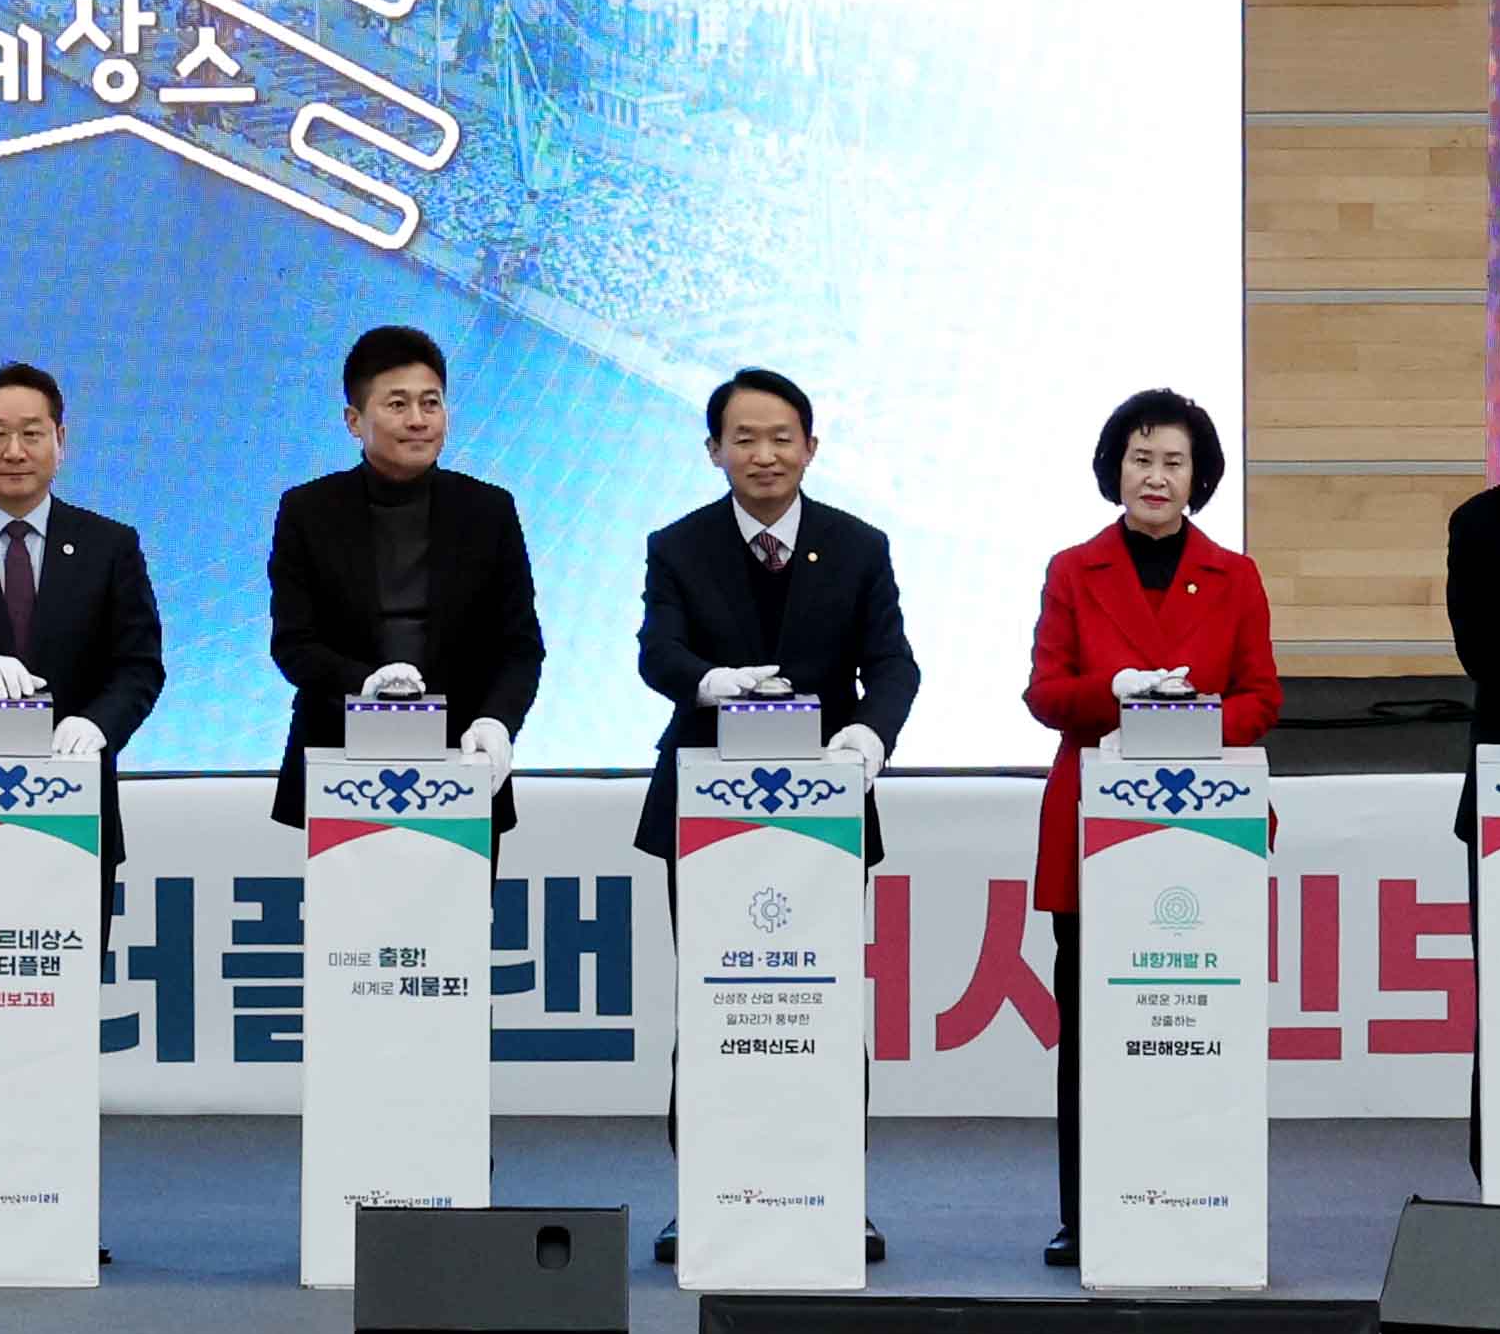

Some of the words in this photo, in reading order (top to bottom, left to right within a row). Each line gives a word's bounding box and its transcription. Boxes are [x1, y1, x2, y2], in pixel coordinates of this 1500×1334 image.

[329, 952, 371, 967] 미래로
[379, 947, 426, 967] 출항!
[804, 952, 816, 966] R
[1133, 952, 1199, 968] 내항개발
[1205, 953, 1217, 968] R
[352, 982, 394, 996] 세계로
[400, 977, 468, 996] 제물포!
[751, 993, 773, 1004] 산업
[721, 1039, 815, 1054] 산업혁신도시
[1126, 1040, 1221, 1056] 열린해양도시
